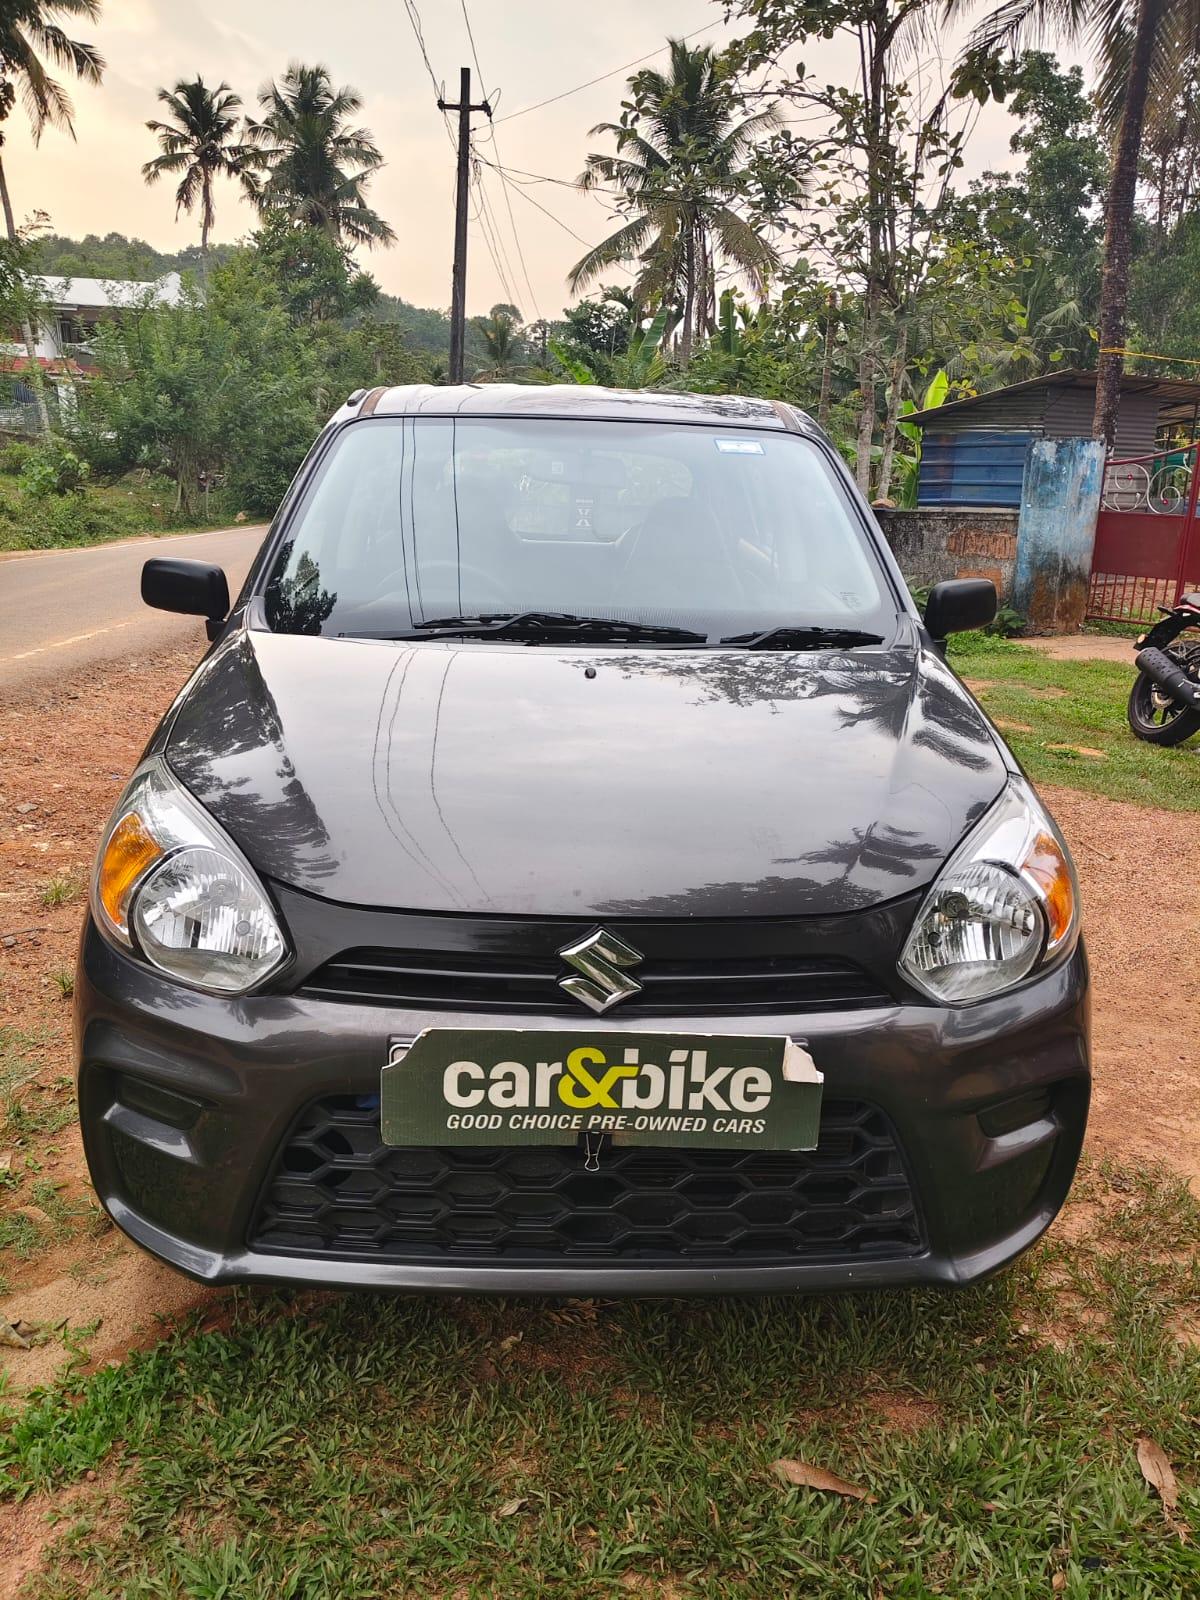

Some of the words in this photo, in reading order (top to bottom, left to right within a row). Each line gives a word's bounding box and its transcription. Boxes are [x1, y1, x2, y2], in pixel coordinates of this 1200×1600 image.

[443, 1047, 772, 1112] car&bike
[446, 1114, 502, 1130] GOOD
[508, 1114, 583, 1130] CHOICE
[587, 1115, 707, 1132] PRE-OWNED
[712, 1118, 766, 1134] CARS
